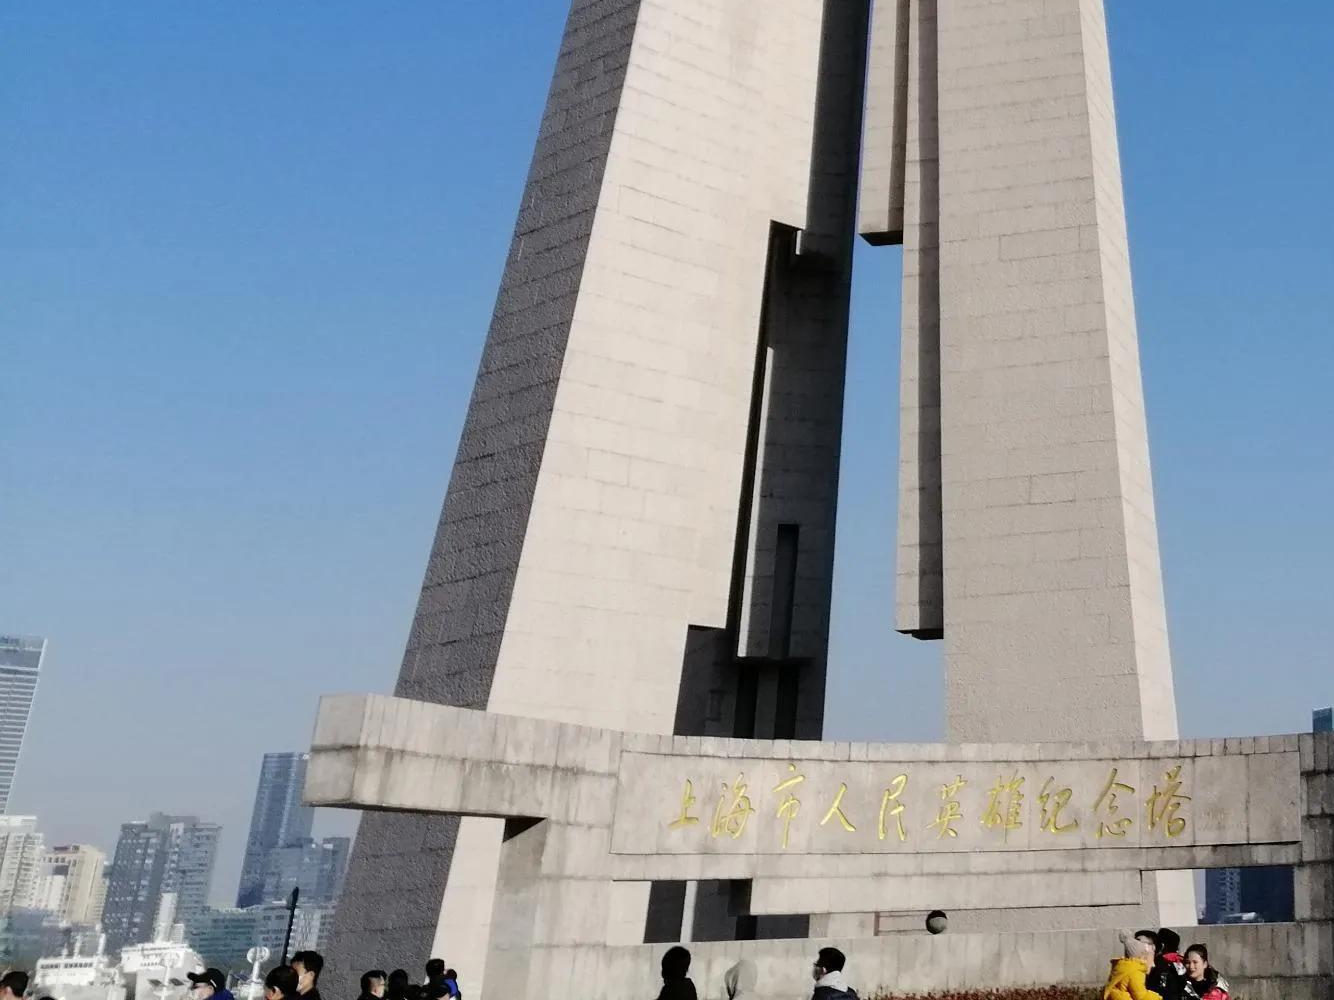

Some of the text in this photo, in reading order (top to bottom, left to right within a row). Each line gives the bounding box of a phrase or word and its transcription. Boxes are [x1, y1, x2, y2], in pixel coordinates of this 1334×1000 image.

[669, 763, 1192, 848] 上海市人民英雄纪念塔
